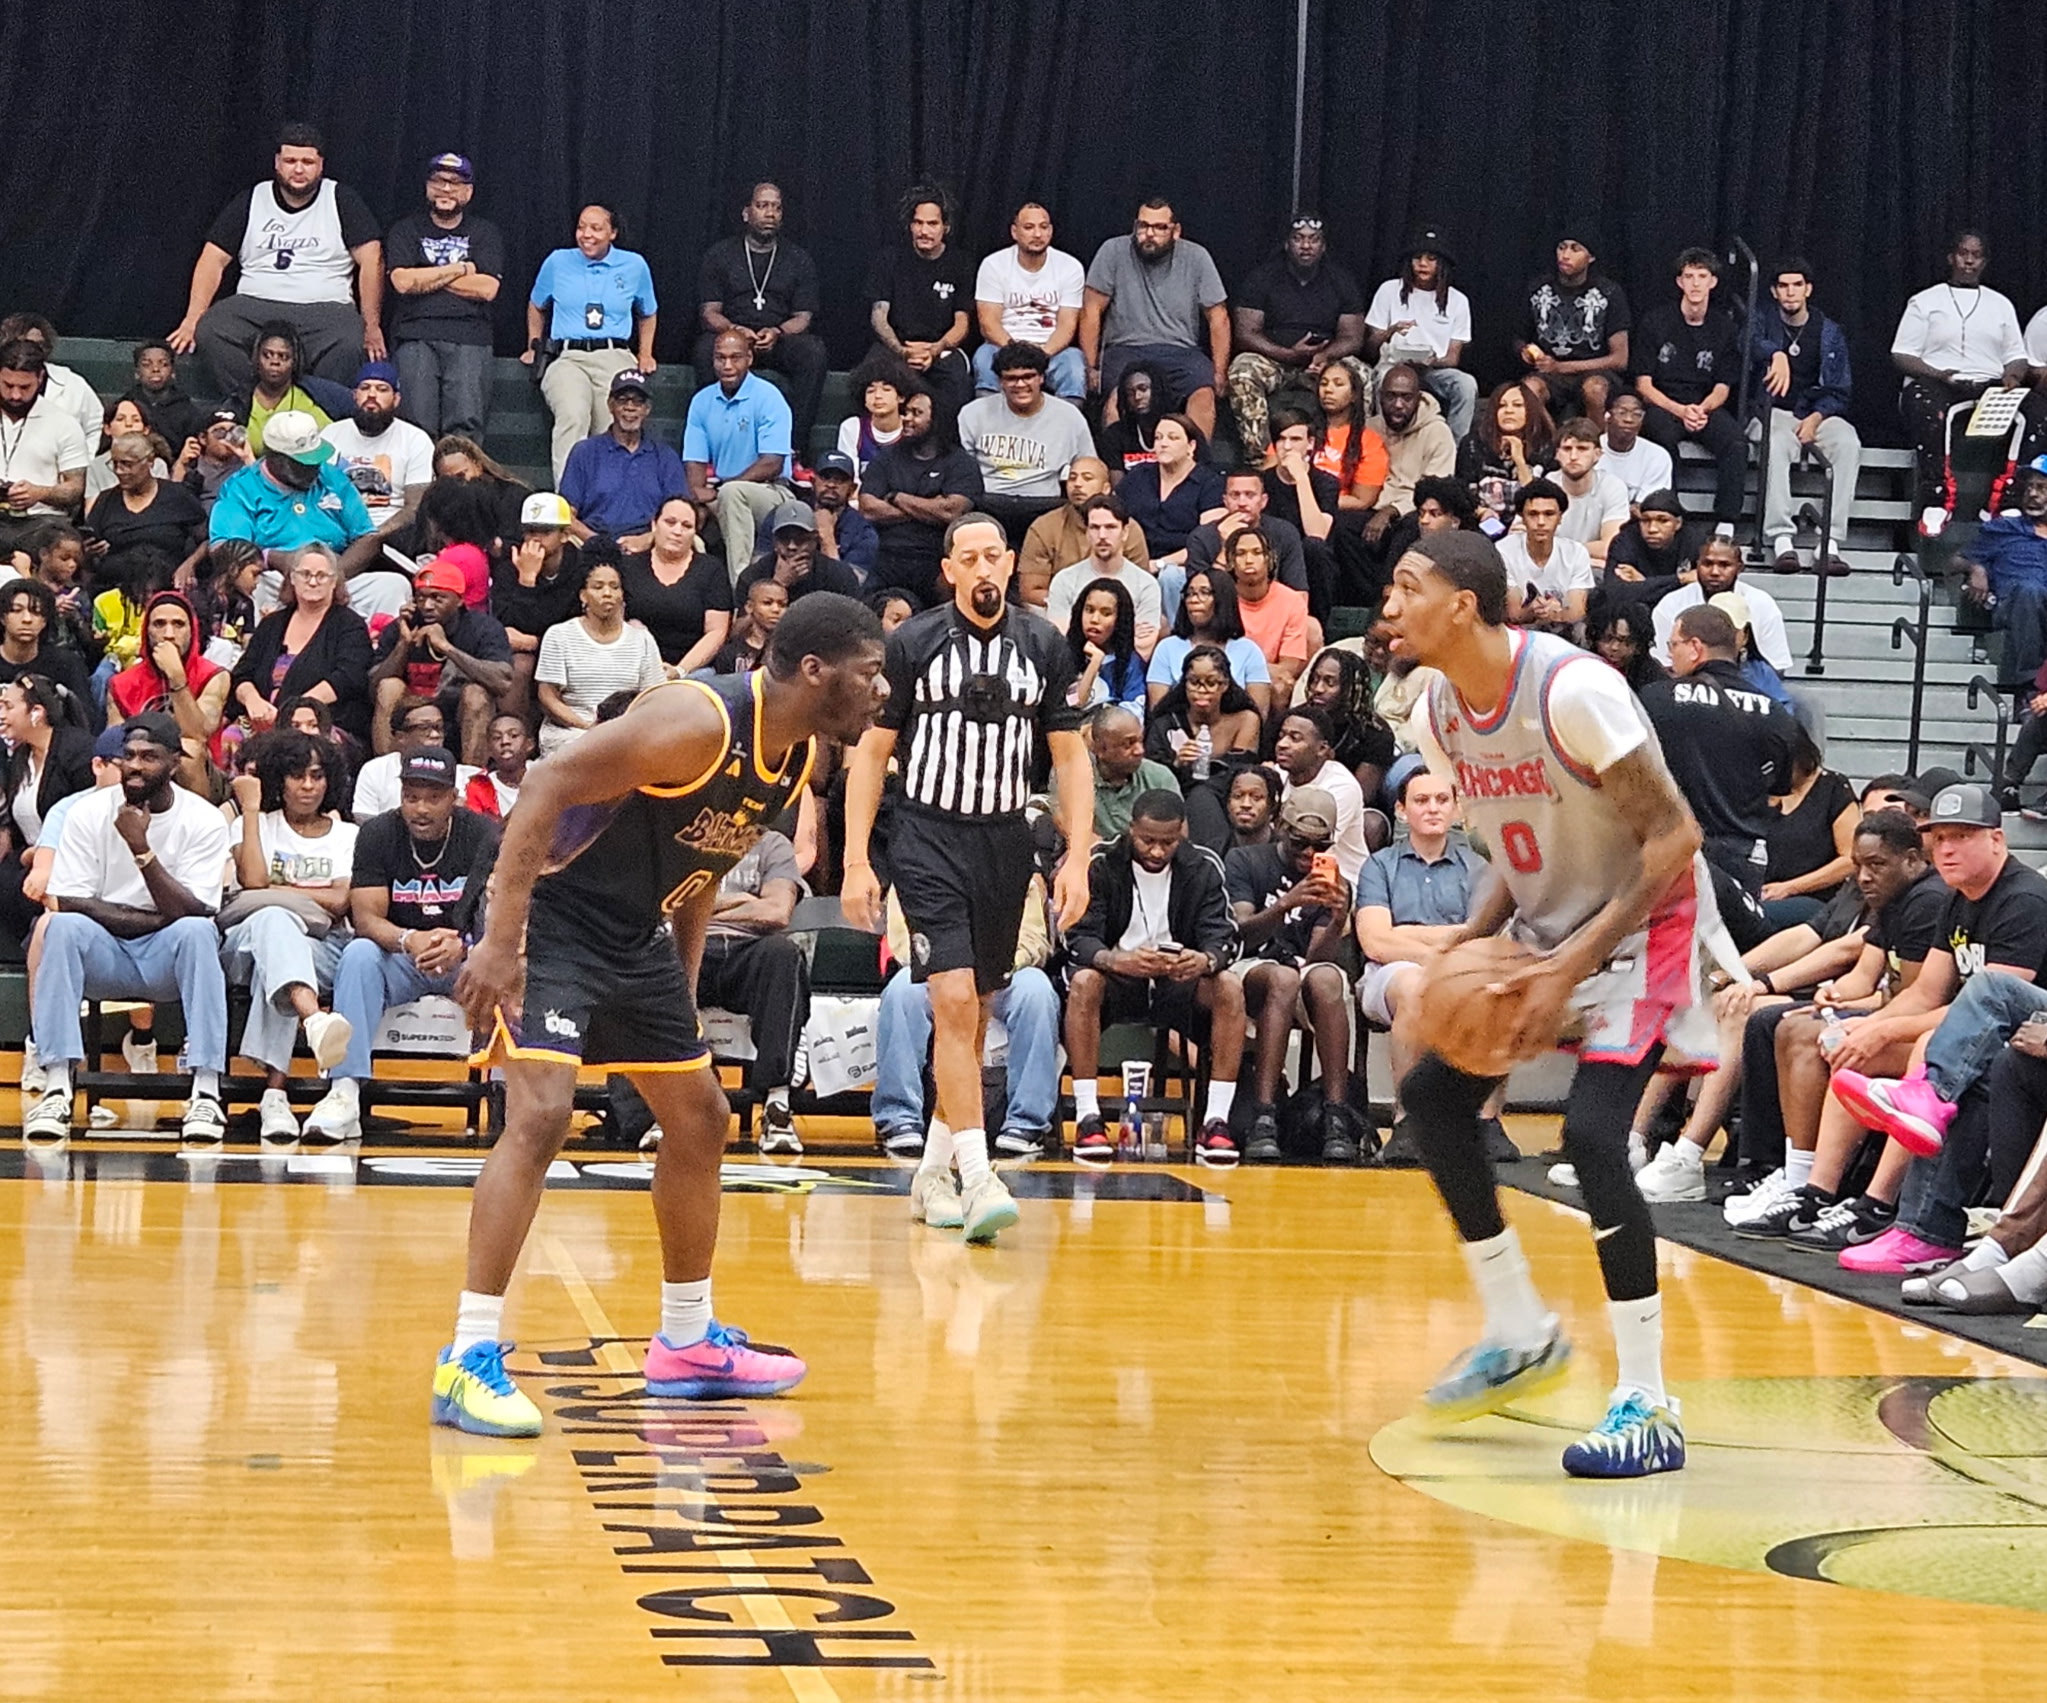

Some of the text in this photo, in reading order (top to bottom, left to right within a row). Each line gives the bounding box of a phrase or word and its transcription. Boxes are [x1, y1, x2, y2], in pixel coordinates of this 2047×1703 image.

[273, 249, 295, 270] 6
[980, 433, 1047, 470] WEKIVA
[1502, 820, 1543, 873] 0
[401, 1033, 428, 1041] SUPER
[593, 1503, 935, 1668] PATCH
